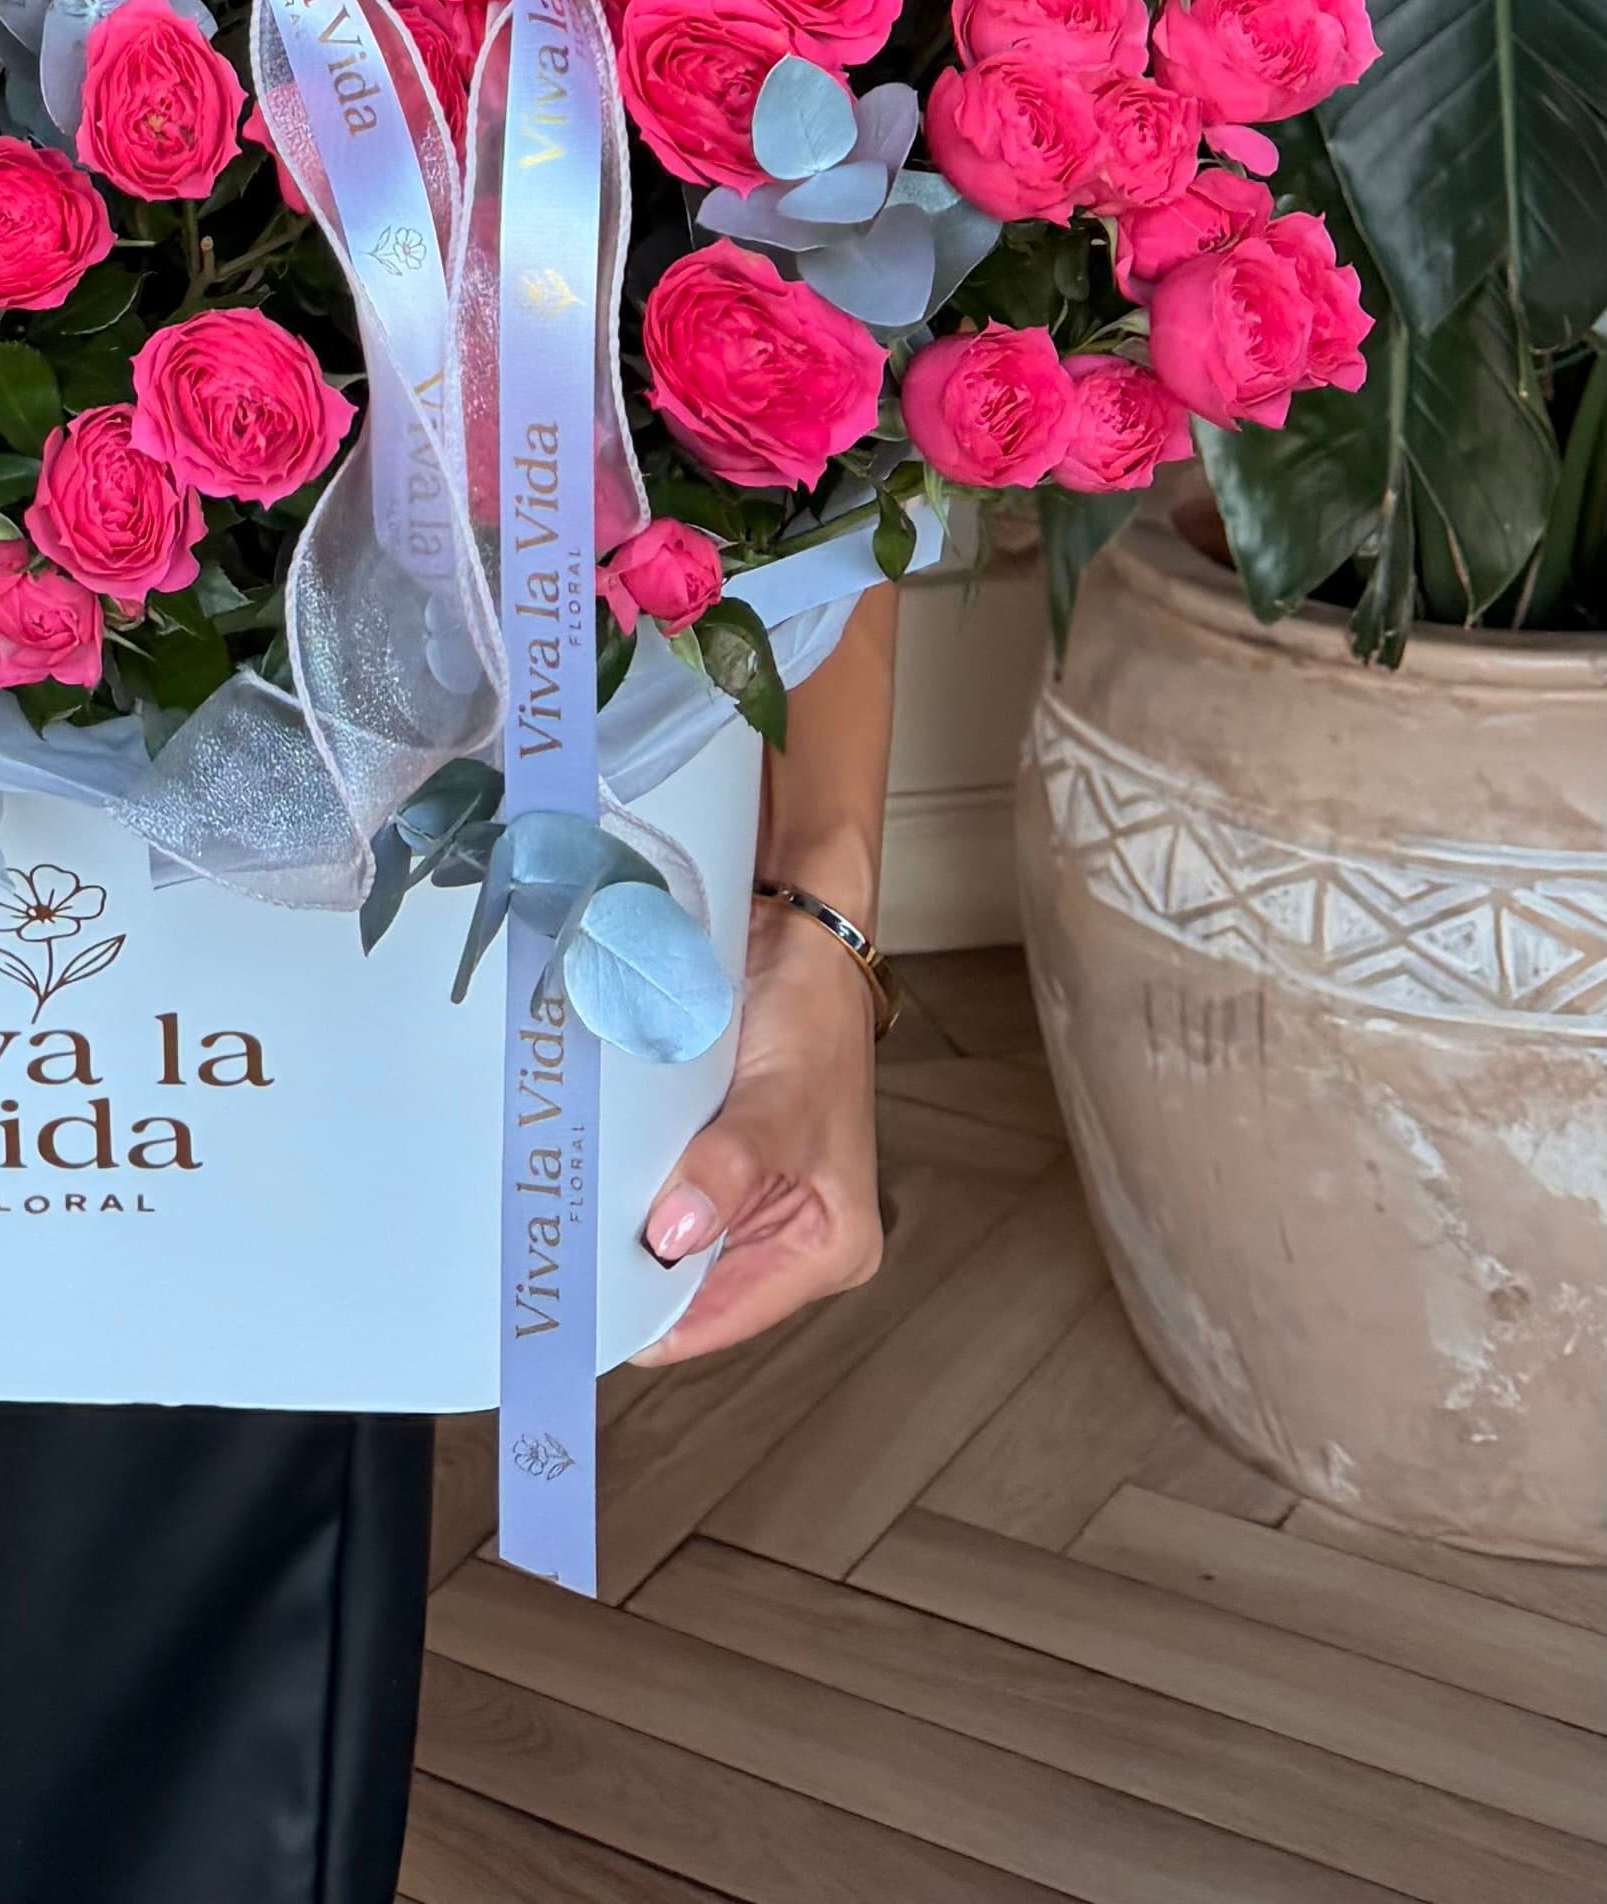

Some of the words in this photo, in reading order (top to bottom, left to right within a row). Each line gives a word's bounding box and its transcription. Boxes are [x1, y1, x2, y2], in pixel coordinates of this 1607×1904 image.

[318, 4, 381, 138] Vida
[519, 44, 570, 169] Viva
[513, 420, 560, 553] Vida
[515, 569, 561, 623] la
[567, 546, 584, 648] FLORAL
[519, 637, 564, 761] Viva
[155, 1012, 276, 1089] la
[517, 993, 567, 1128] Vida
[516, 1146, 563, 1198] la
[568, 1123, 586, 1225] FLORAL
[516, 1214, 562, 1340] Viva
